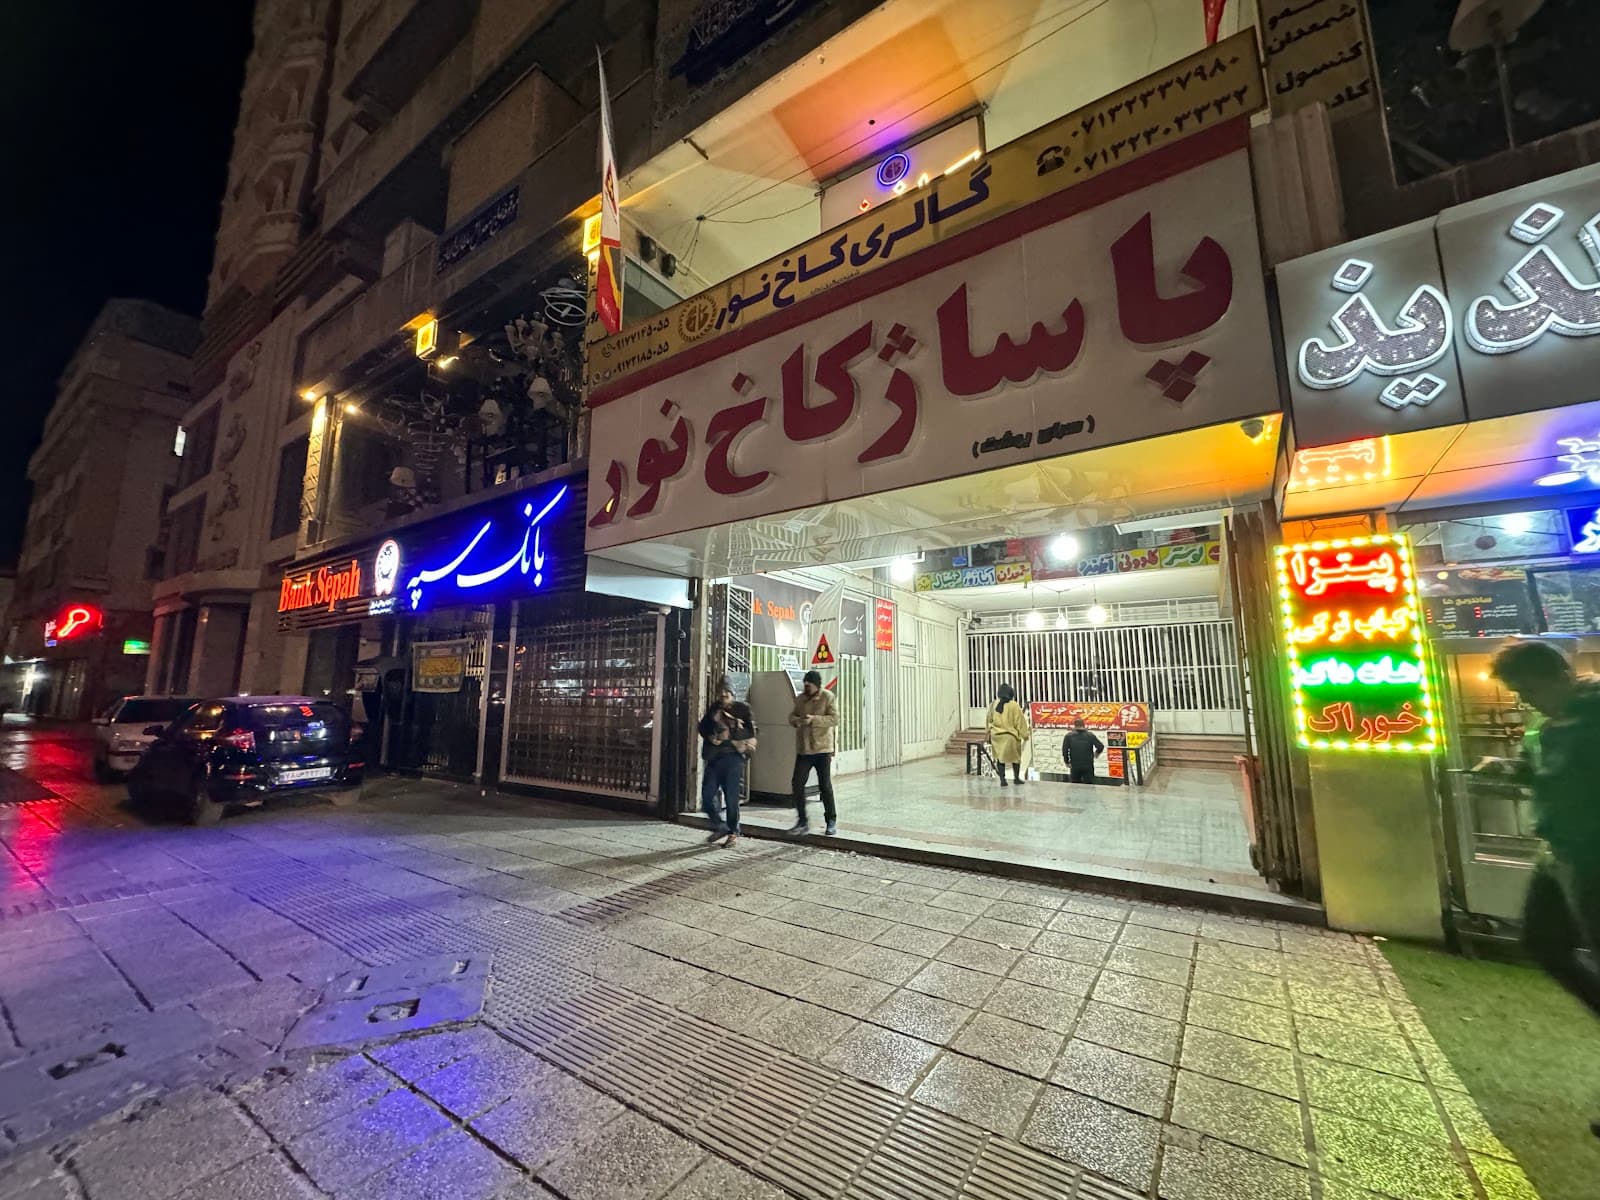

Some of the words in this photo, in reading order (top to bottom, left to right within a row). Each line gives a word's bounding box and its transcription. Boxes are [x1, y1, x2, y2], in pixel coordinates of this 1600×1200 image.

[1275, 41, 1362, 94] کنسول
[850, 160, 992, 267] گالری
[714, 272, 771, 331] نور
[772, 233, 848, 308] کاخ
[704, 321, 873, 494] کاخ
[589, 399, 690, 530] نور
[406, 520, 491, 611] سپه
[456, 484, 567, 588] بانک
[278, 570, 313, 613] Bank
[314, 560, 361, 613] Sepah
[1290, 552, 1396, 596] پیتزا
[766, 600, 796, 624] Sepah
[1307, 702, 1425, 742] خوراک
